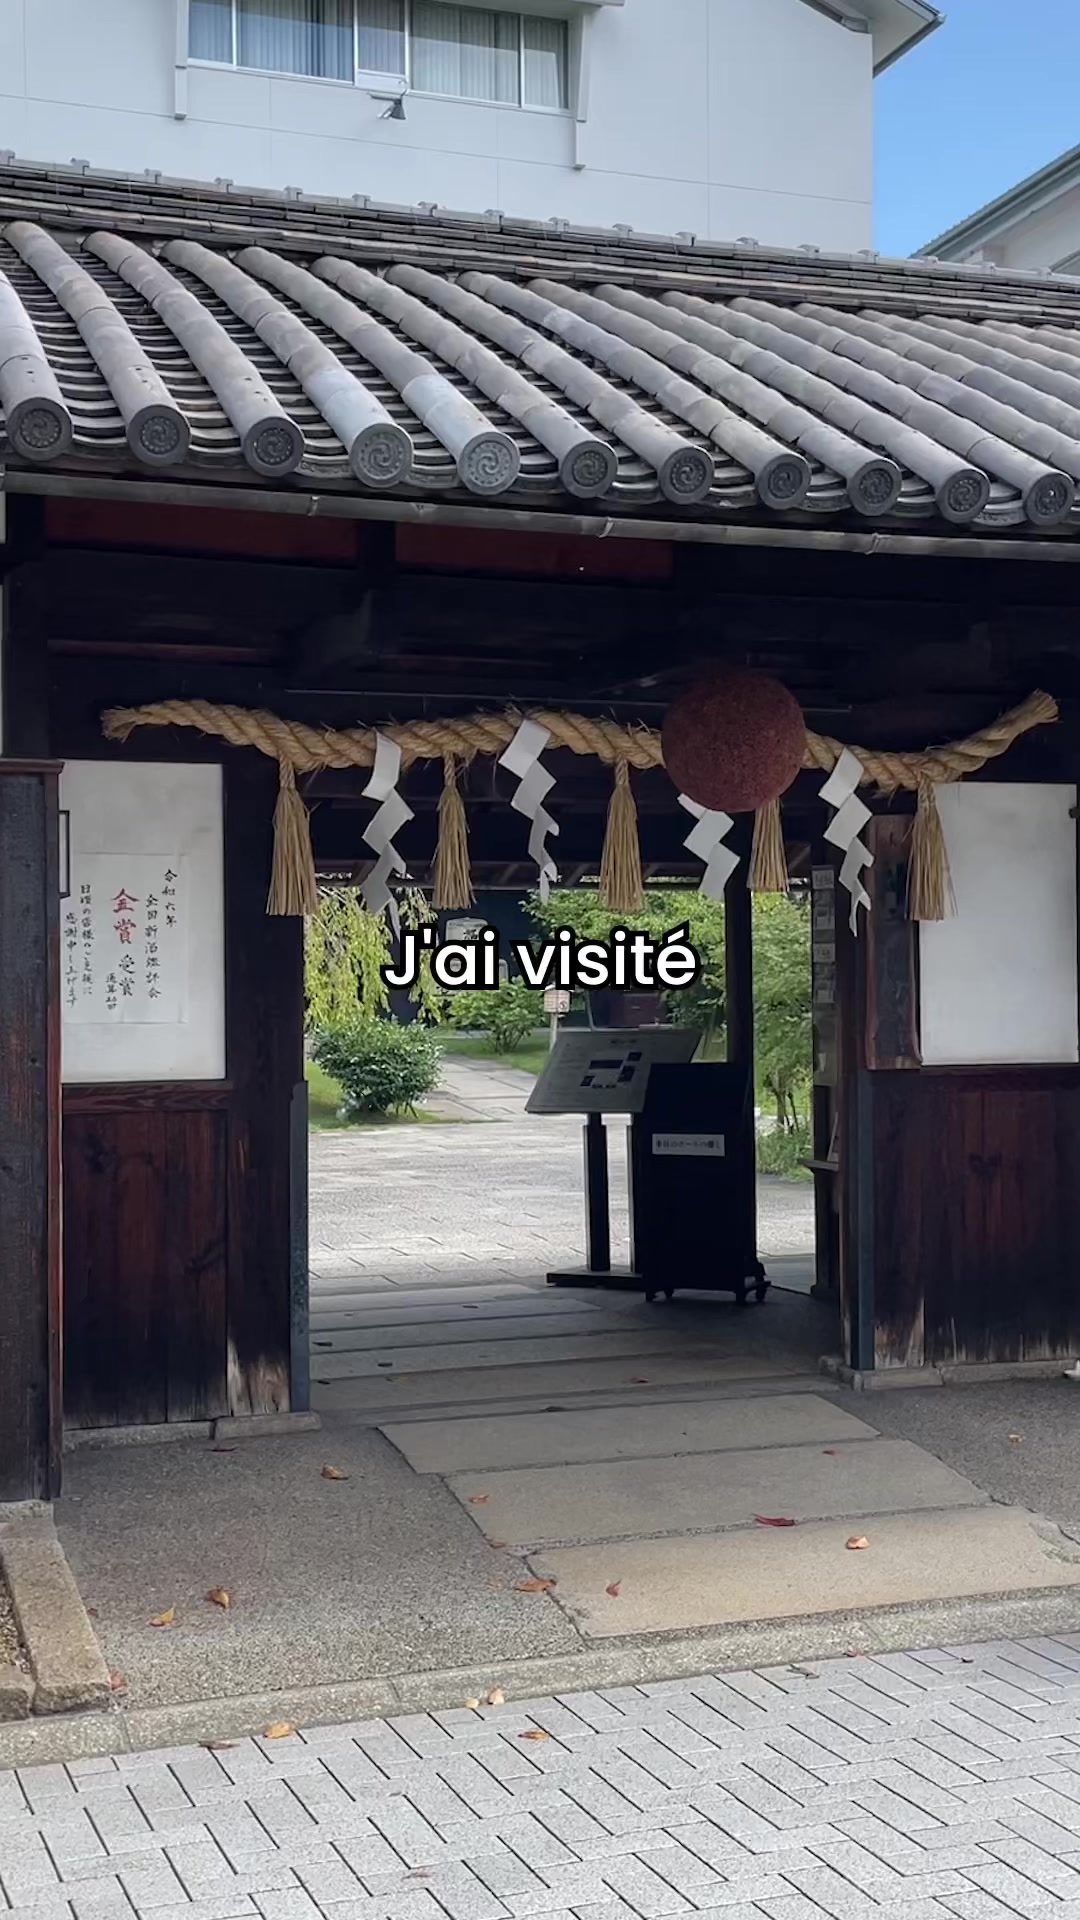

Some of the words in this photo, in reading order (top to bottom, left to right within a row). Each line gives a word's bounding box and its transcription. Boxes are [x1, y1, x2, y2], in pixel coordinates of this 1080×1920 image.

[111, 888, 140, 945] 金賞
[161, 868, 179, 928] 令和六年
